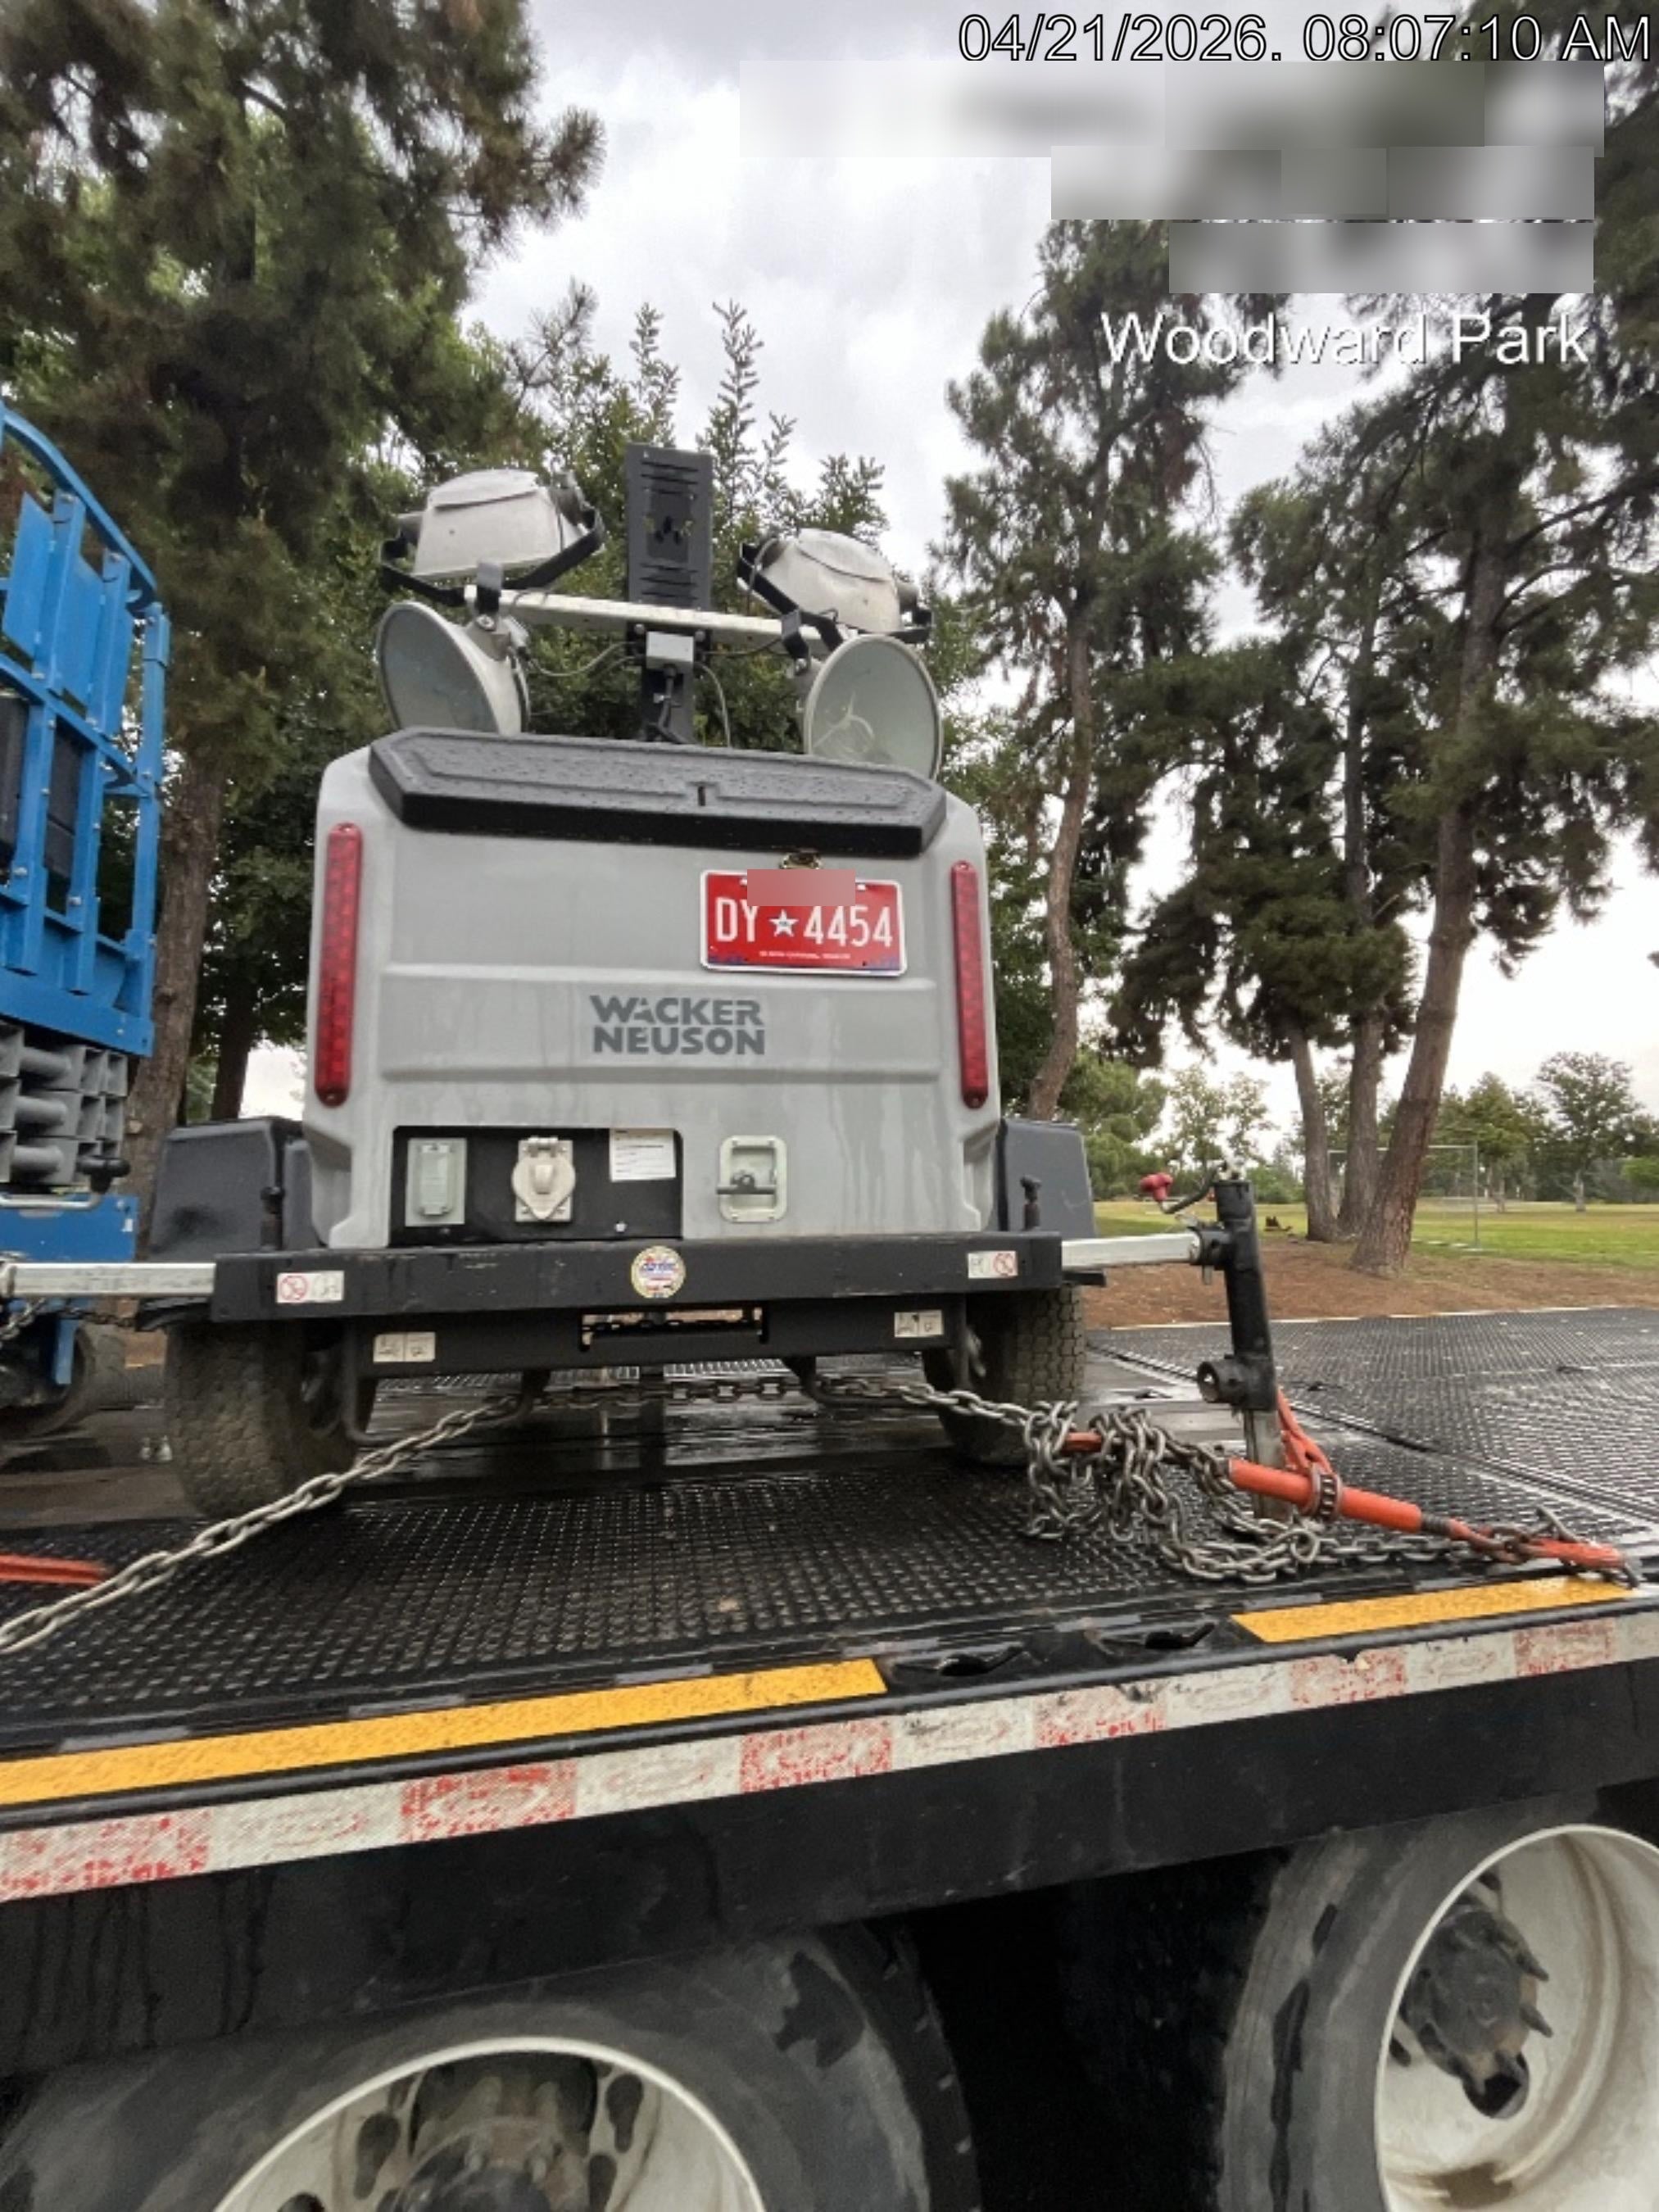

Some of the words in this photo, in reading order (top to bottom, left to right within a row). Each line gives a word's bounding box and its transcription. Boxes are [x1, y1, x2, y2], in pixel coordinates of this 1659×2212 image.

[715, 896, 760, 943] DY
[803, 904, 894, 948] 4454
[590, 995, 764, 1026] WACKER
[592, 1026, 765, 1055] NEUSON
